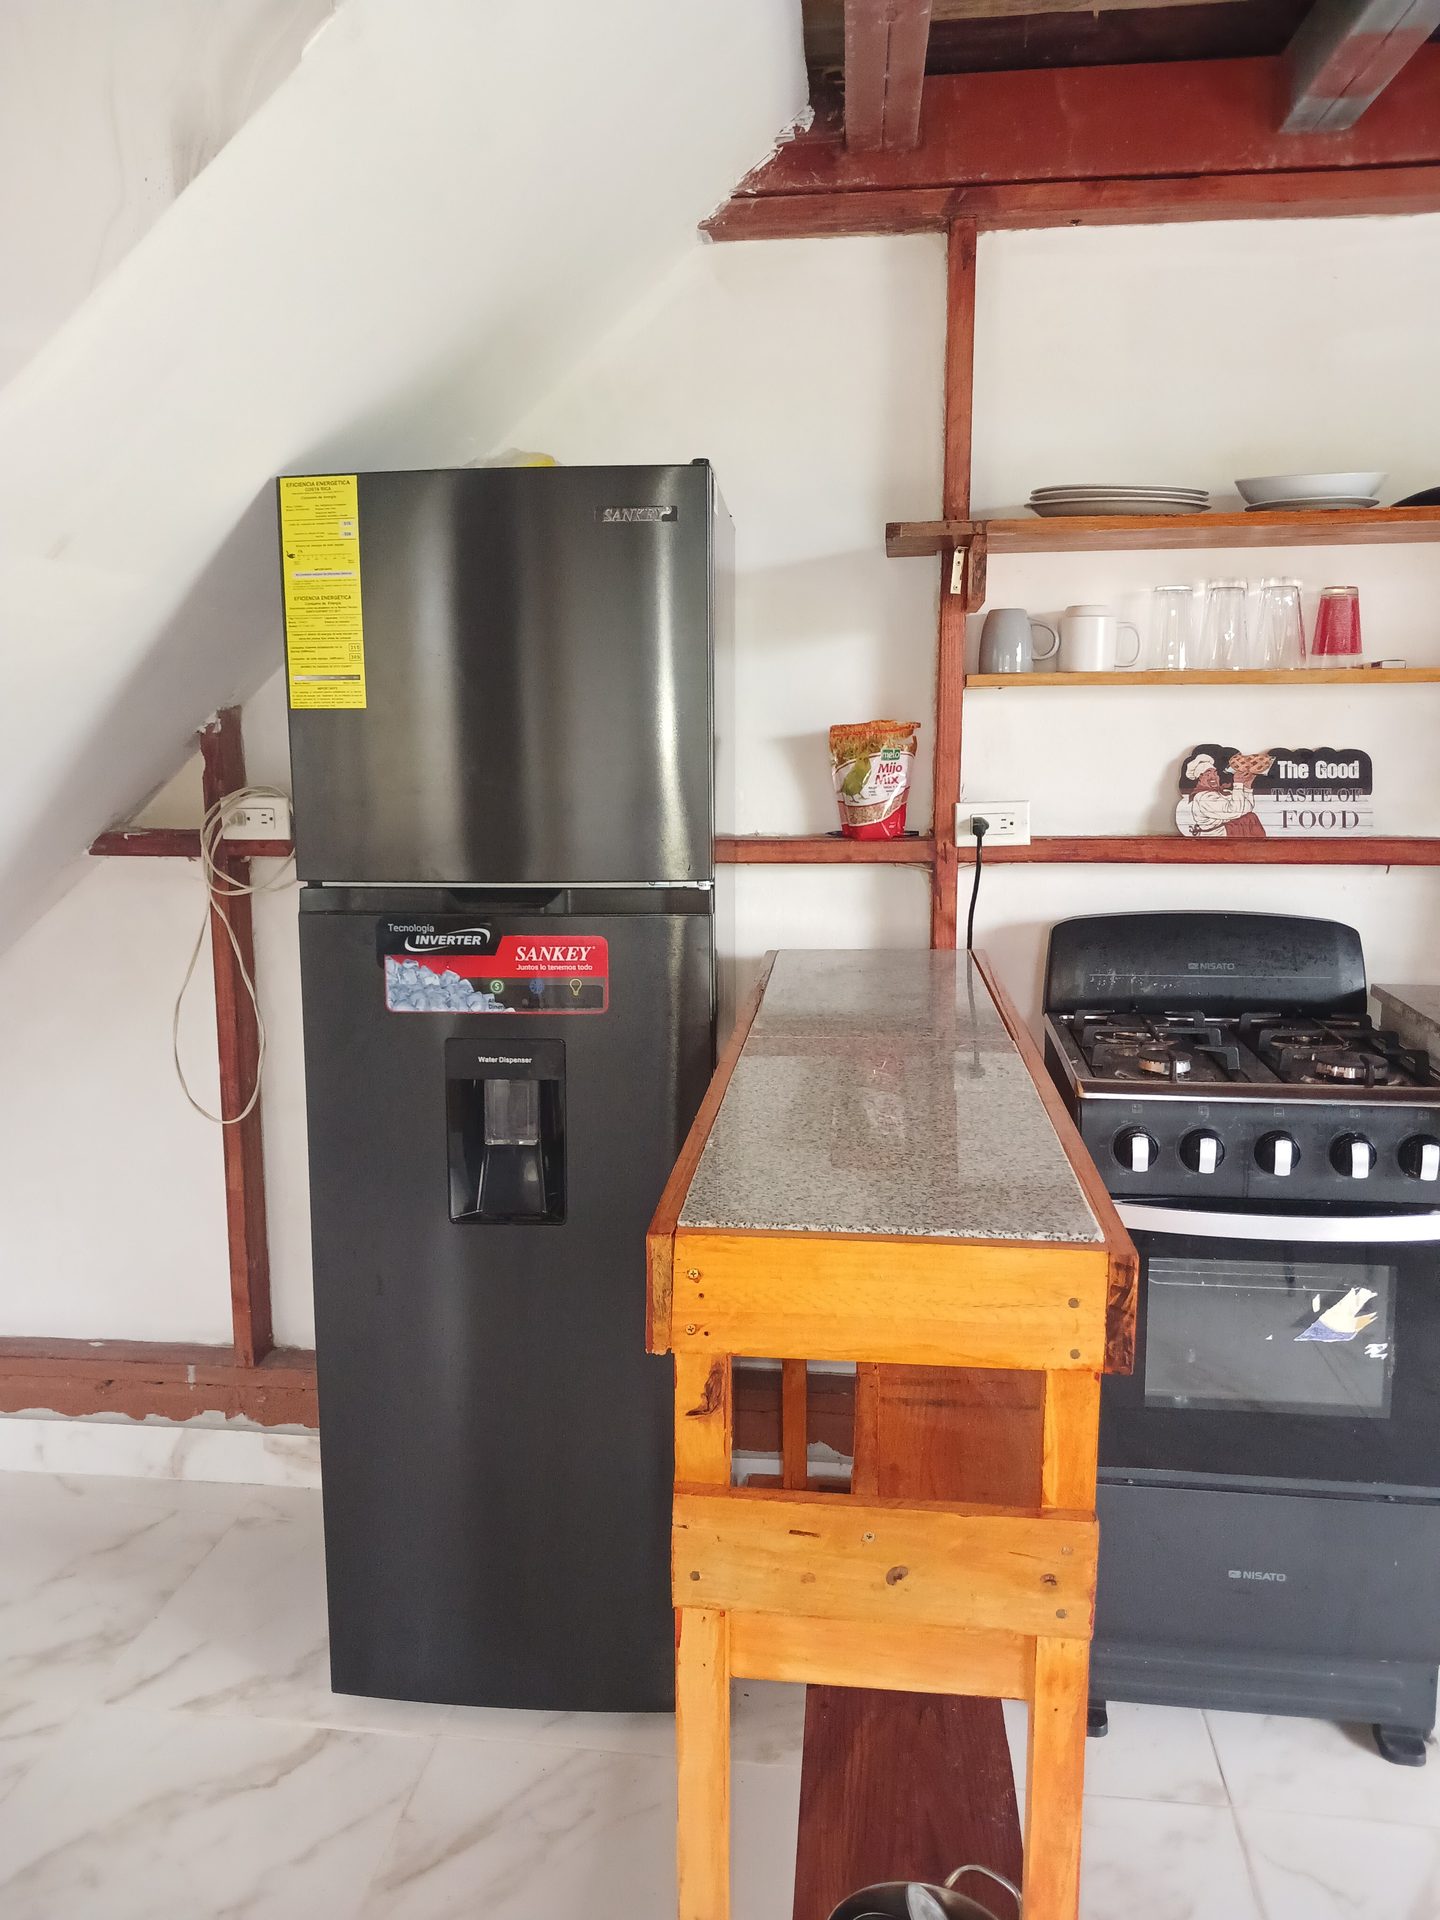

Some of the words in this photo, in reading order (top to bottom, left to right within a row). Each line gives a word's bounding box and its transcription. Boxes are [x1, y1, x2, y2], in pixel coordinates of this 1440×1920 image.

[877, 762, 903, 773] Mijo
[1277, 760, 1310, 779] The
[1315, 760, 1360, 779] Good
[875, 773, 899, 785] Mix
[1270, 787, 1332, 803] TASTE
[1337, 787, 1363, 803] OF
[1281, 810, 1360, 829] FOOD
[415, 934, 482, 946] INVERTER
[515, 963, 538, 971] Juntos
[539, 963, 547, 971] lo
[577, 963, 593, 971] todo
[1200, 962, 1235, 970] NISATO
[498, 1056, 533, 1065] Dispenser
[1242, 1571, 1287, 1582] NISATO
